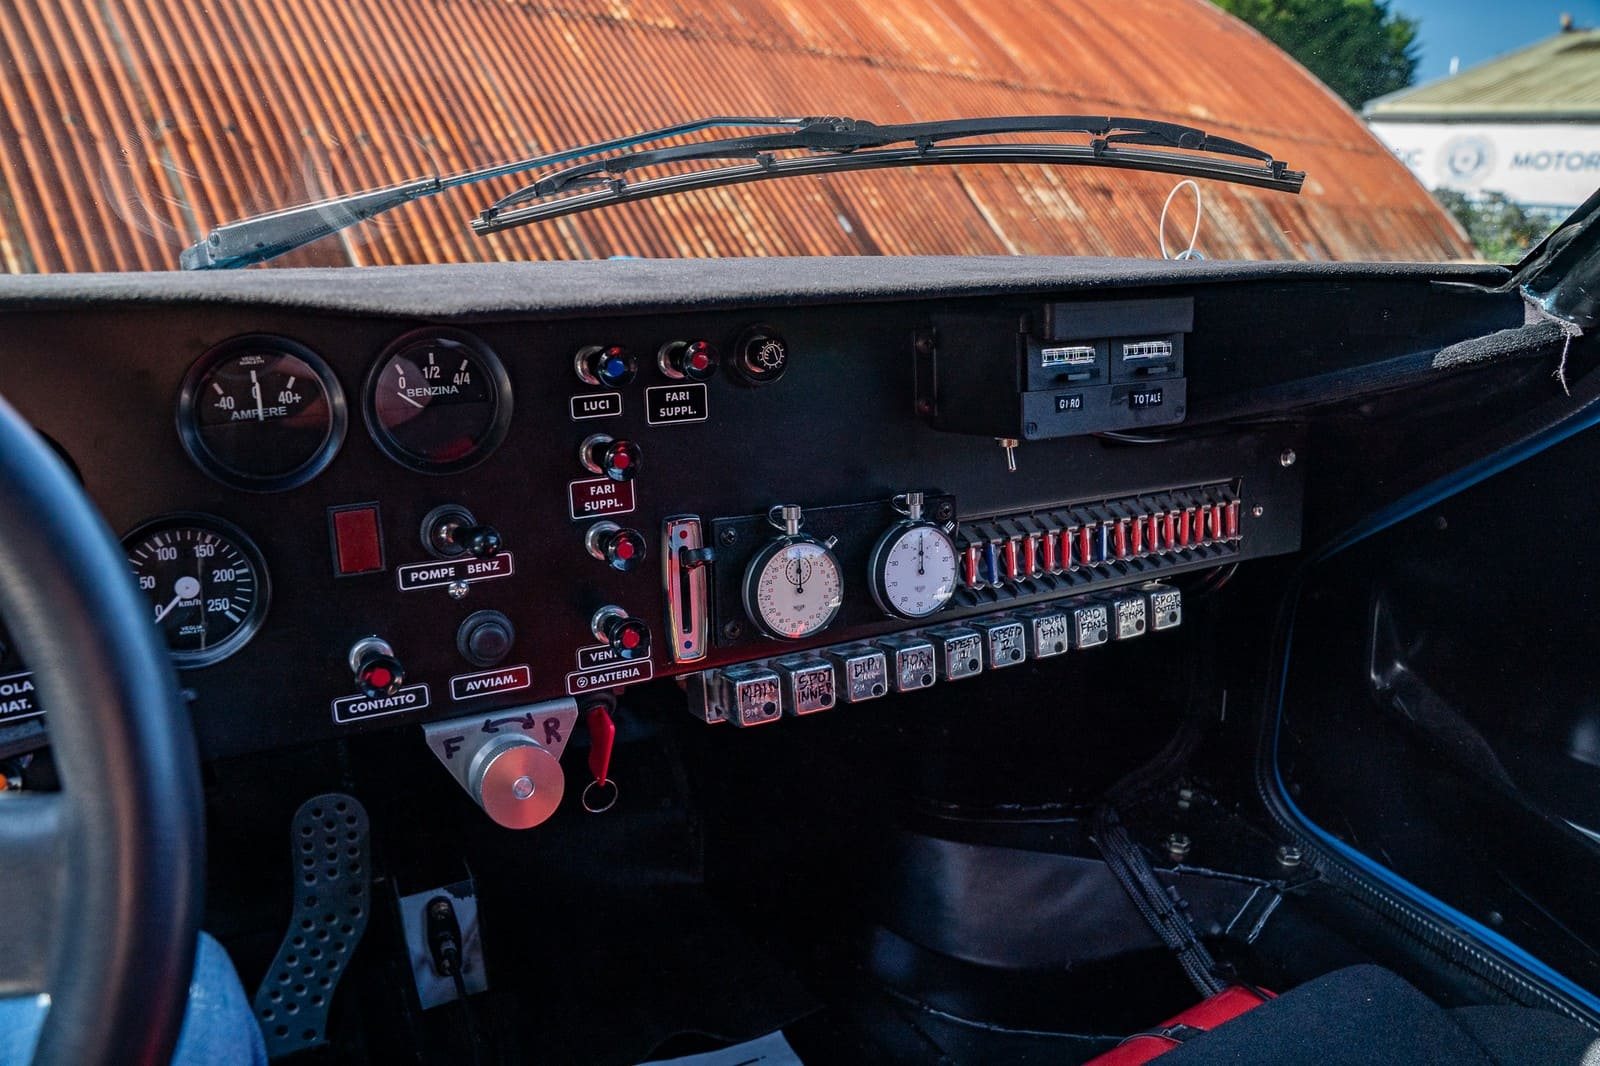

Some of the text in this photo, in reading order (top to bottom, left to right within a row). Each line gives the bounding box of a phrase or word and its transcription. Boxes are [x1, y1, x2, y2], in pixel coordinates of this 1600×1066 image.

[422, 366, 440, 379] 1/2
[453, 372, 470, 385] 4/4
[398, 376, 406, 389] 0
[407, 385, 459, 397] BENZINA
[665, 391, 690, 402] FARI
[214, 396, 235, 410] -40
[583, 400, 610, 411] LUCI
[1059, 398, 1080, 409] GIRO
[1134, 393, 1161, 405] TOTALE
[231, 406, 287, 420] AMPERE
[659, 405, 697, 417] SUPPL.
[590, 484, 616, 496] FARI
[584, 498, 624, 512] SUPPL.
[156, 547, 177, 561] 100
[193, 544, 215, 557] 150
[212, 568, 235, 582] 200
[411, 560, 500, 582] POMPE BENZ
[139, 576, 156, 589] 50
[178, 599, 202, 607] km/h
[207, 599, 230, 612] 250
[1155, 594, 1179, 606] SPOT
[1042, 626, 1065, 639] FAN
[590, 650, 617, 662] VEN
[854, 657, 875, 678] DIP
[465, 674, 518, 692] AVVIAM.
[590, 668, 640, 685] BATTERIA
[798, 669, 832, 690] SPOT
[0, 681, 34, 696] OLA
[798, 683, 834, 704] INNER
[0, 698, 32, 713] IAT.
[349, 693, 416, 714] CONTATTO
[543, 717, 562, 745] R
[443, 735, 465, 759] F
